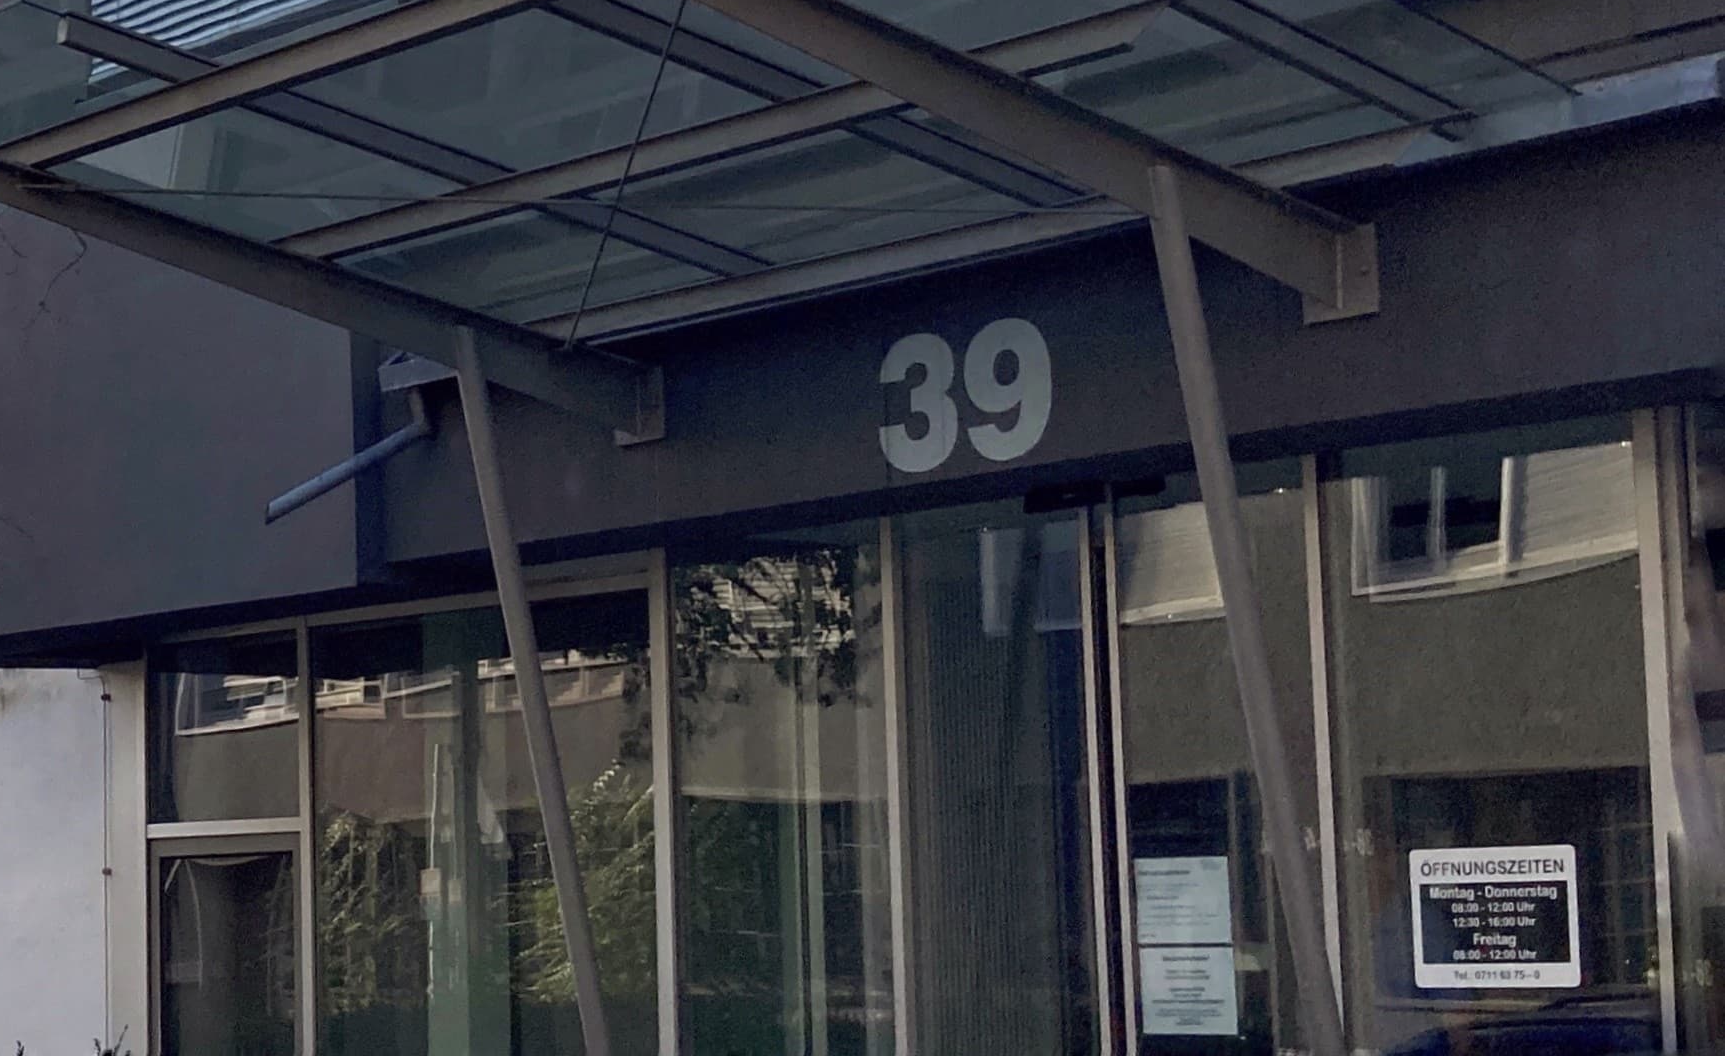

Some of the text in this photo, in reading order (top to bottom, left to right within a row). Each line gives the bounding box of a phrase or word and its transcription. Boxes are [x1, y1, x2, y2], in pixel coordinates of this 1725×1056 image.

[879, 318, 1052, 472] 39
[1420, 858, 1565, 876] ÖFFNUNGSZEITEN
[1429, 887, 1475, 901] Montag
[1485, 885, 1557, 900] Donnerstag
[1451, 903, 1479, 913] 08:00
[1487, 902, 1514, 913] 12:00
[1516, 902, 1536, 912] Uhr
[1517, 917, 1537, 926] Uhr
[1473, 932, 1517, 947] Freitag
[1489, 949, 1516, 960] 12:00
[1518, 949, 1537, 959] Uhr
